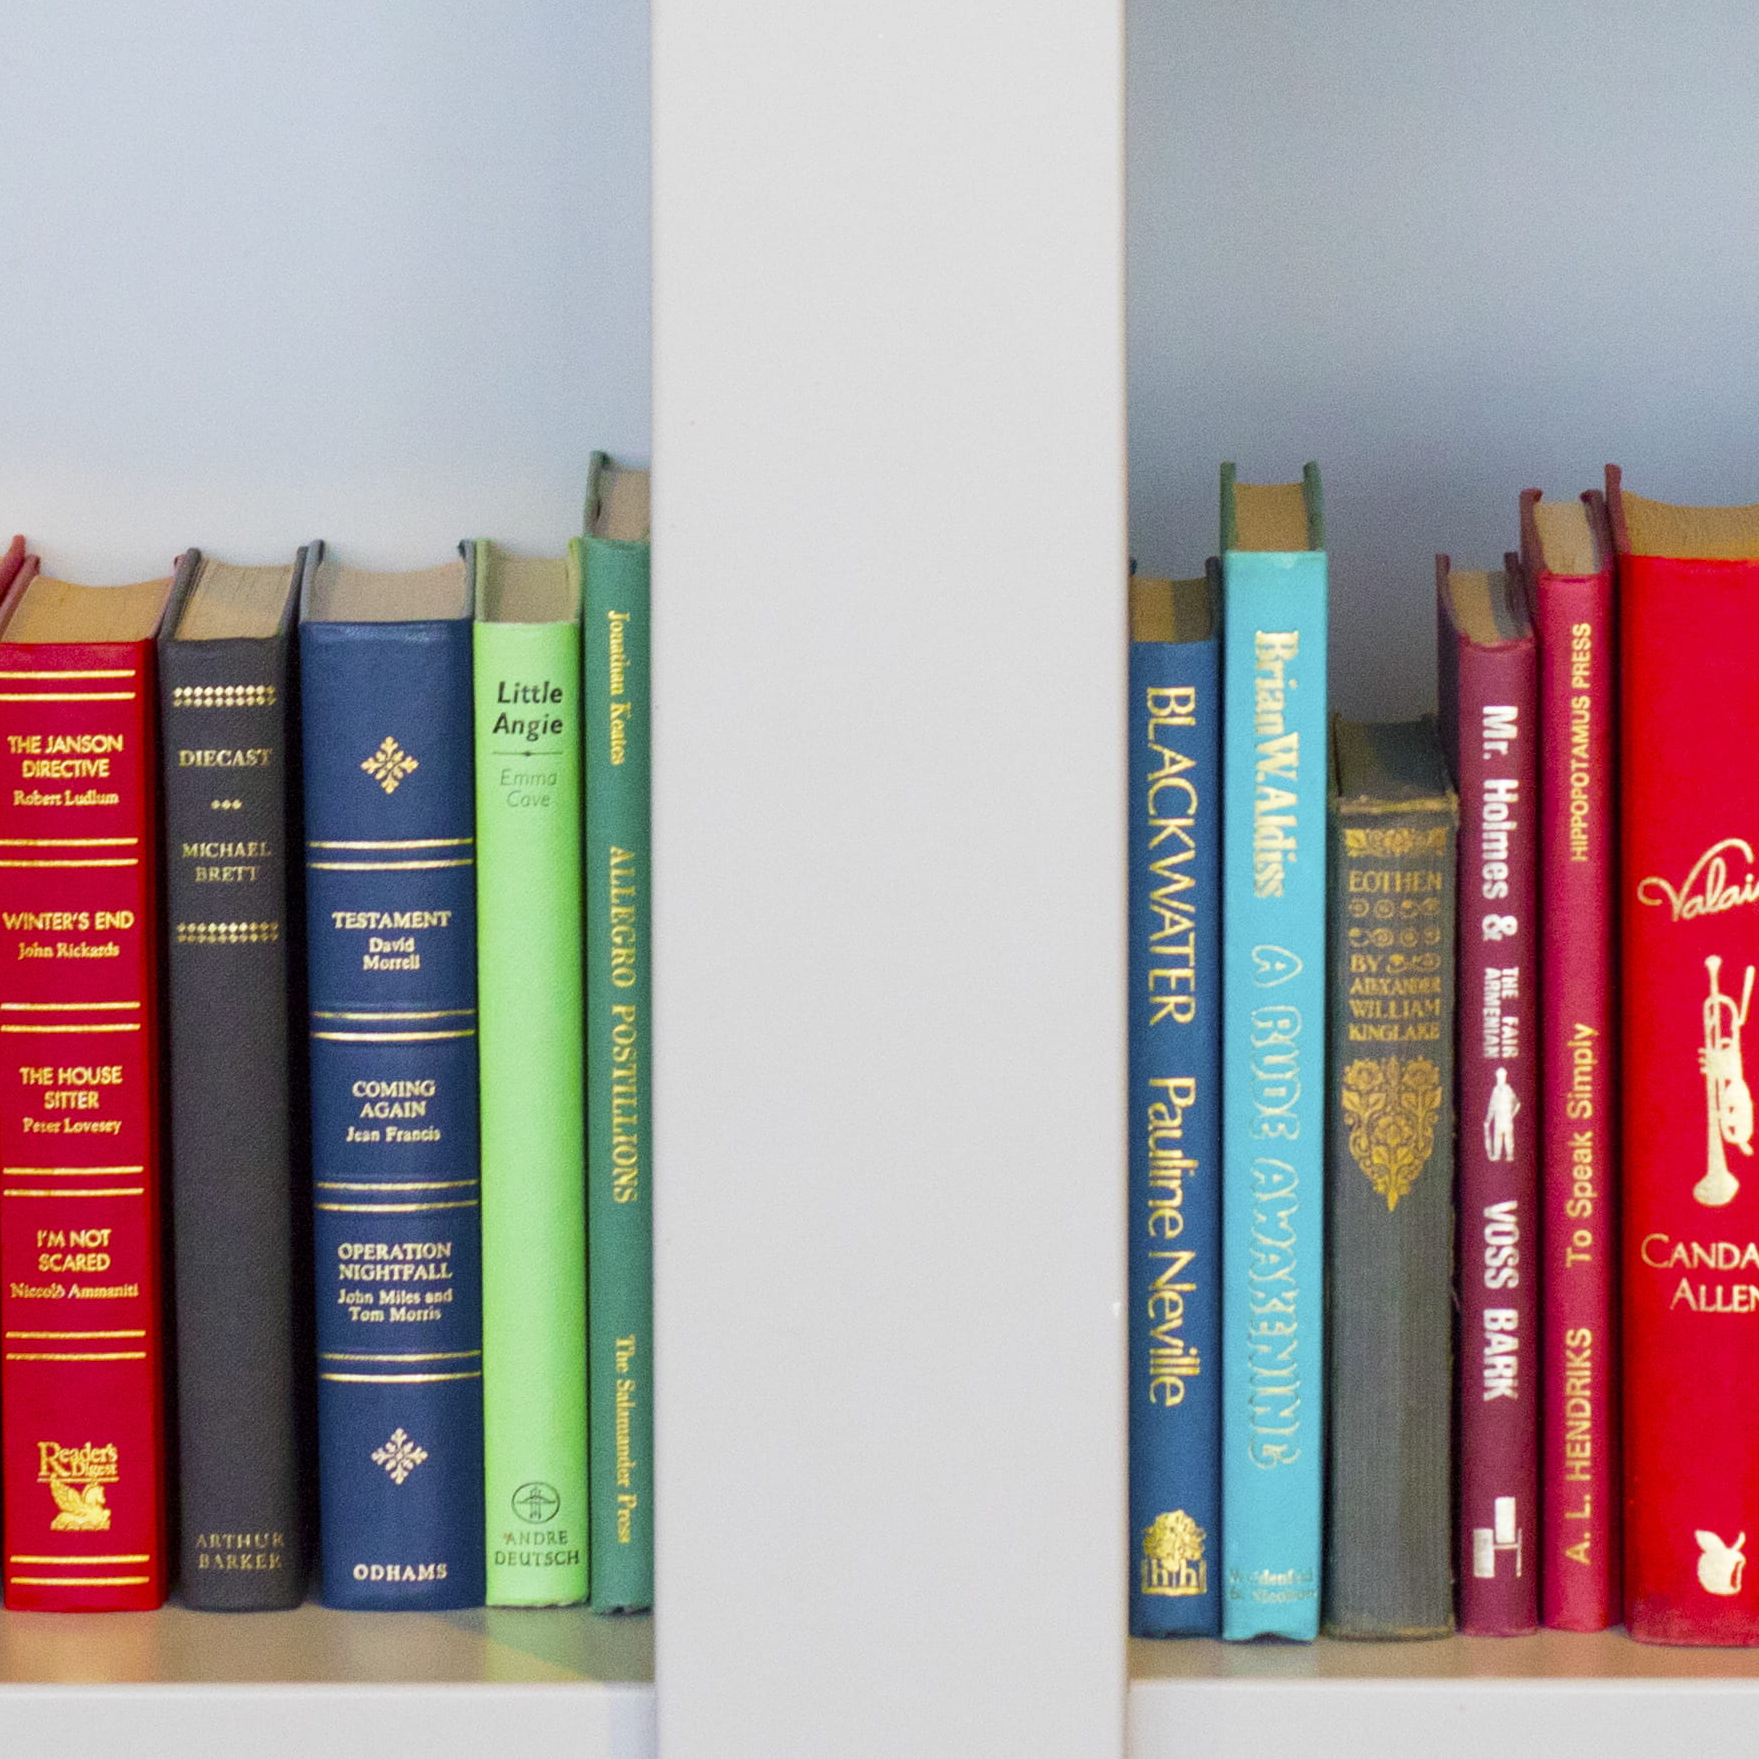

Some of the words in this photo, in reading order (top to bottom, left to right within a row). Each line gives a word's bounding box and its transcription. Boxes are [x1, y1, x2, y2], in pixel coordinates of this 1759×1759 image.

[498, 681, 563, 704] Little
[1255, 631, 1299, 733] Brian
[8, 735, 42, 754] THE
[45, 734, 123, 754] JANSON
[493, 713, 563, 740] Angie
[1482, 705, 1518, 760] Mr.
[22, 757, 109, 778] DIRECTIVE
[180, 750, 271, 767] DIECAST
[1146, 686, 1197, 1025] BLACKWATER
[1482, 779, 1519, 899] Holmes
[332, 911, 451, 928] TESTAMENT
[368, 937, 414, 954] David
[1568, 1023, 1599, 1119] Simply
[1148, 1077, 1197, 1239] Pauline
[1567, 1131, 1598, 1217] Speak
[38, 1253, 111, 1271] SCARED
[70, 1229, 111, 1247] NOT
[1484, 1201, 1519, 1289] VOSS
[1567, 1232, 1592, 1267] To
[1148, 1250, 1200, 1406] Neville
[1484, 1308, 1519, 1402] BARK
[1567, 1328, 1592, 1481] HENDRIKS
